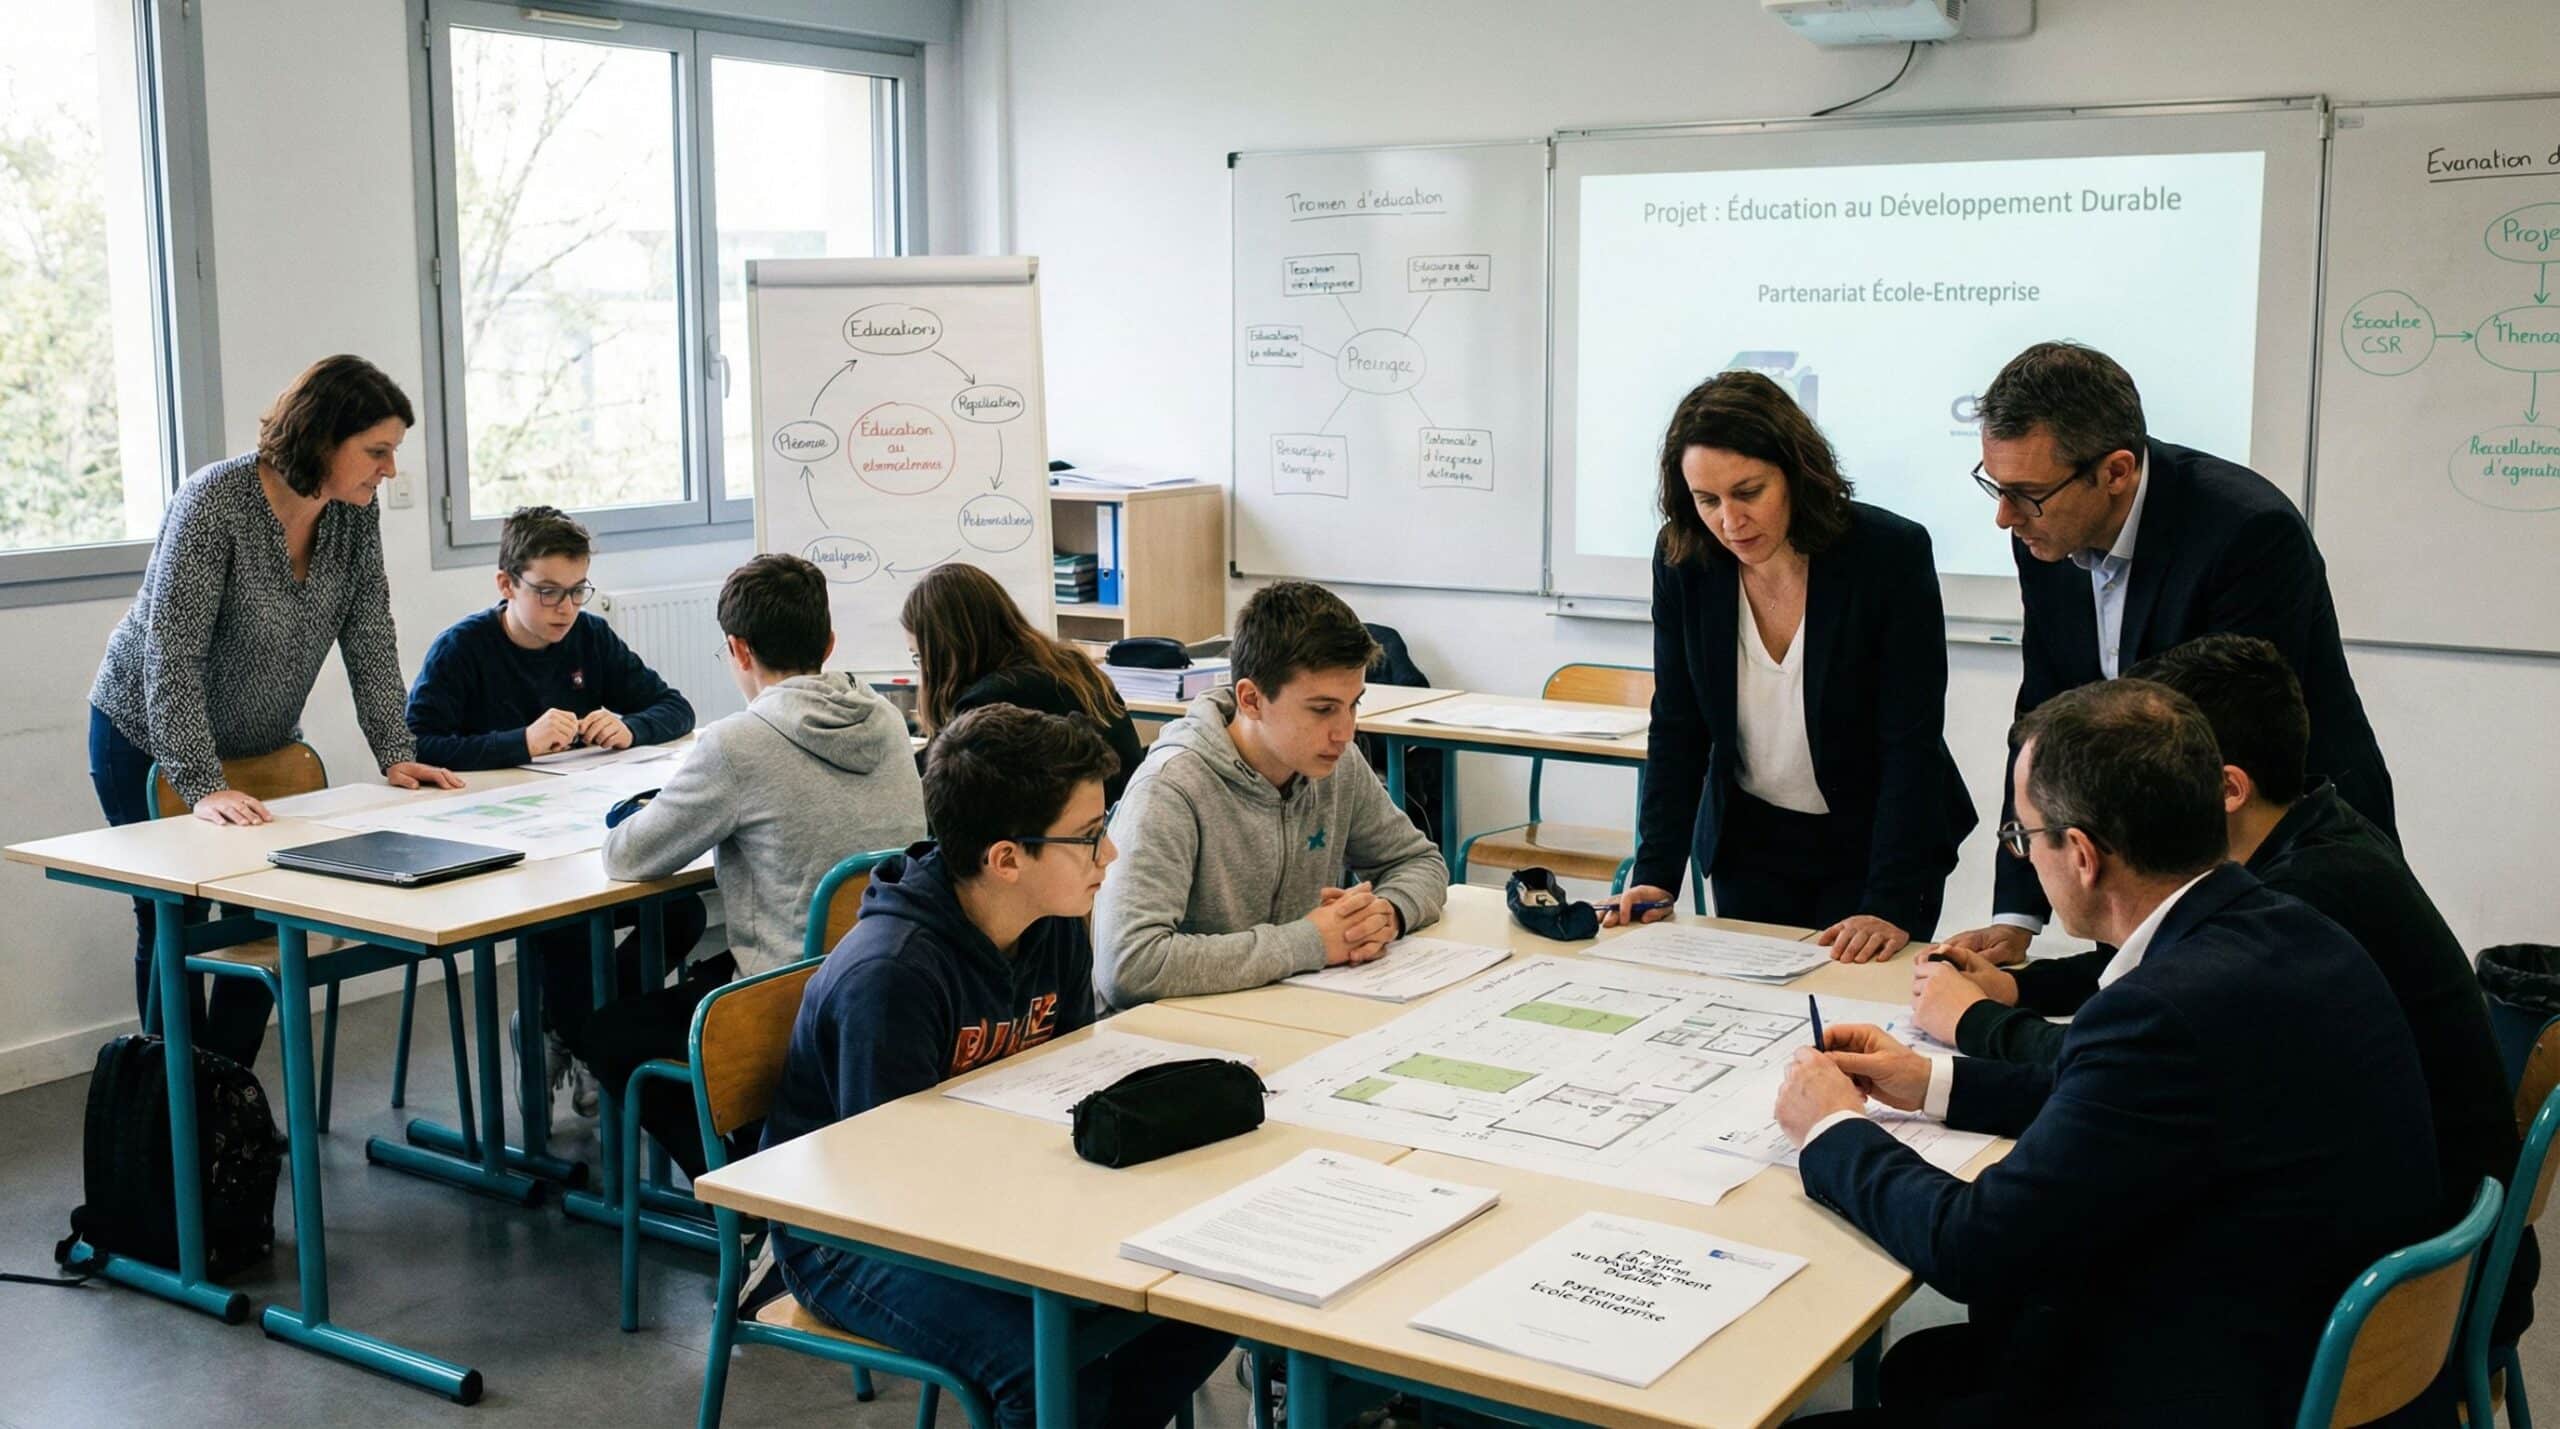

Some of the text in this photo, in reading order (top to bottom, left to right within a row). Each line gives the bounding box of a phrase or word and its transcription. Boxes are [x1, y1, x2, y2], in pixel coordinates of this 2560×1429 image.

[1643, 202, 1708, 228] Projet
[1727, 193, 1838, 222] Éducation
[1844, 200, 1872, 218] au
[1880, 191, 2073, 221] Développement
[2081, 186, 2183, 213] Durable
[1758, 279, 2041, 305] Partenariat École-Entreprise
[2361, 335, 2403, 354] CSR
[887, 443, 905, 454] au
[1571, 1252, 1591, 1260] au
[1562, 1280, 1655, 1308] Partenariat
